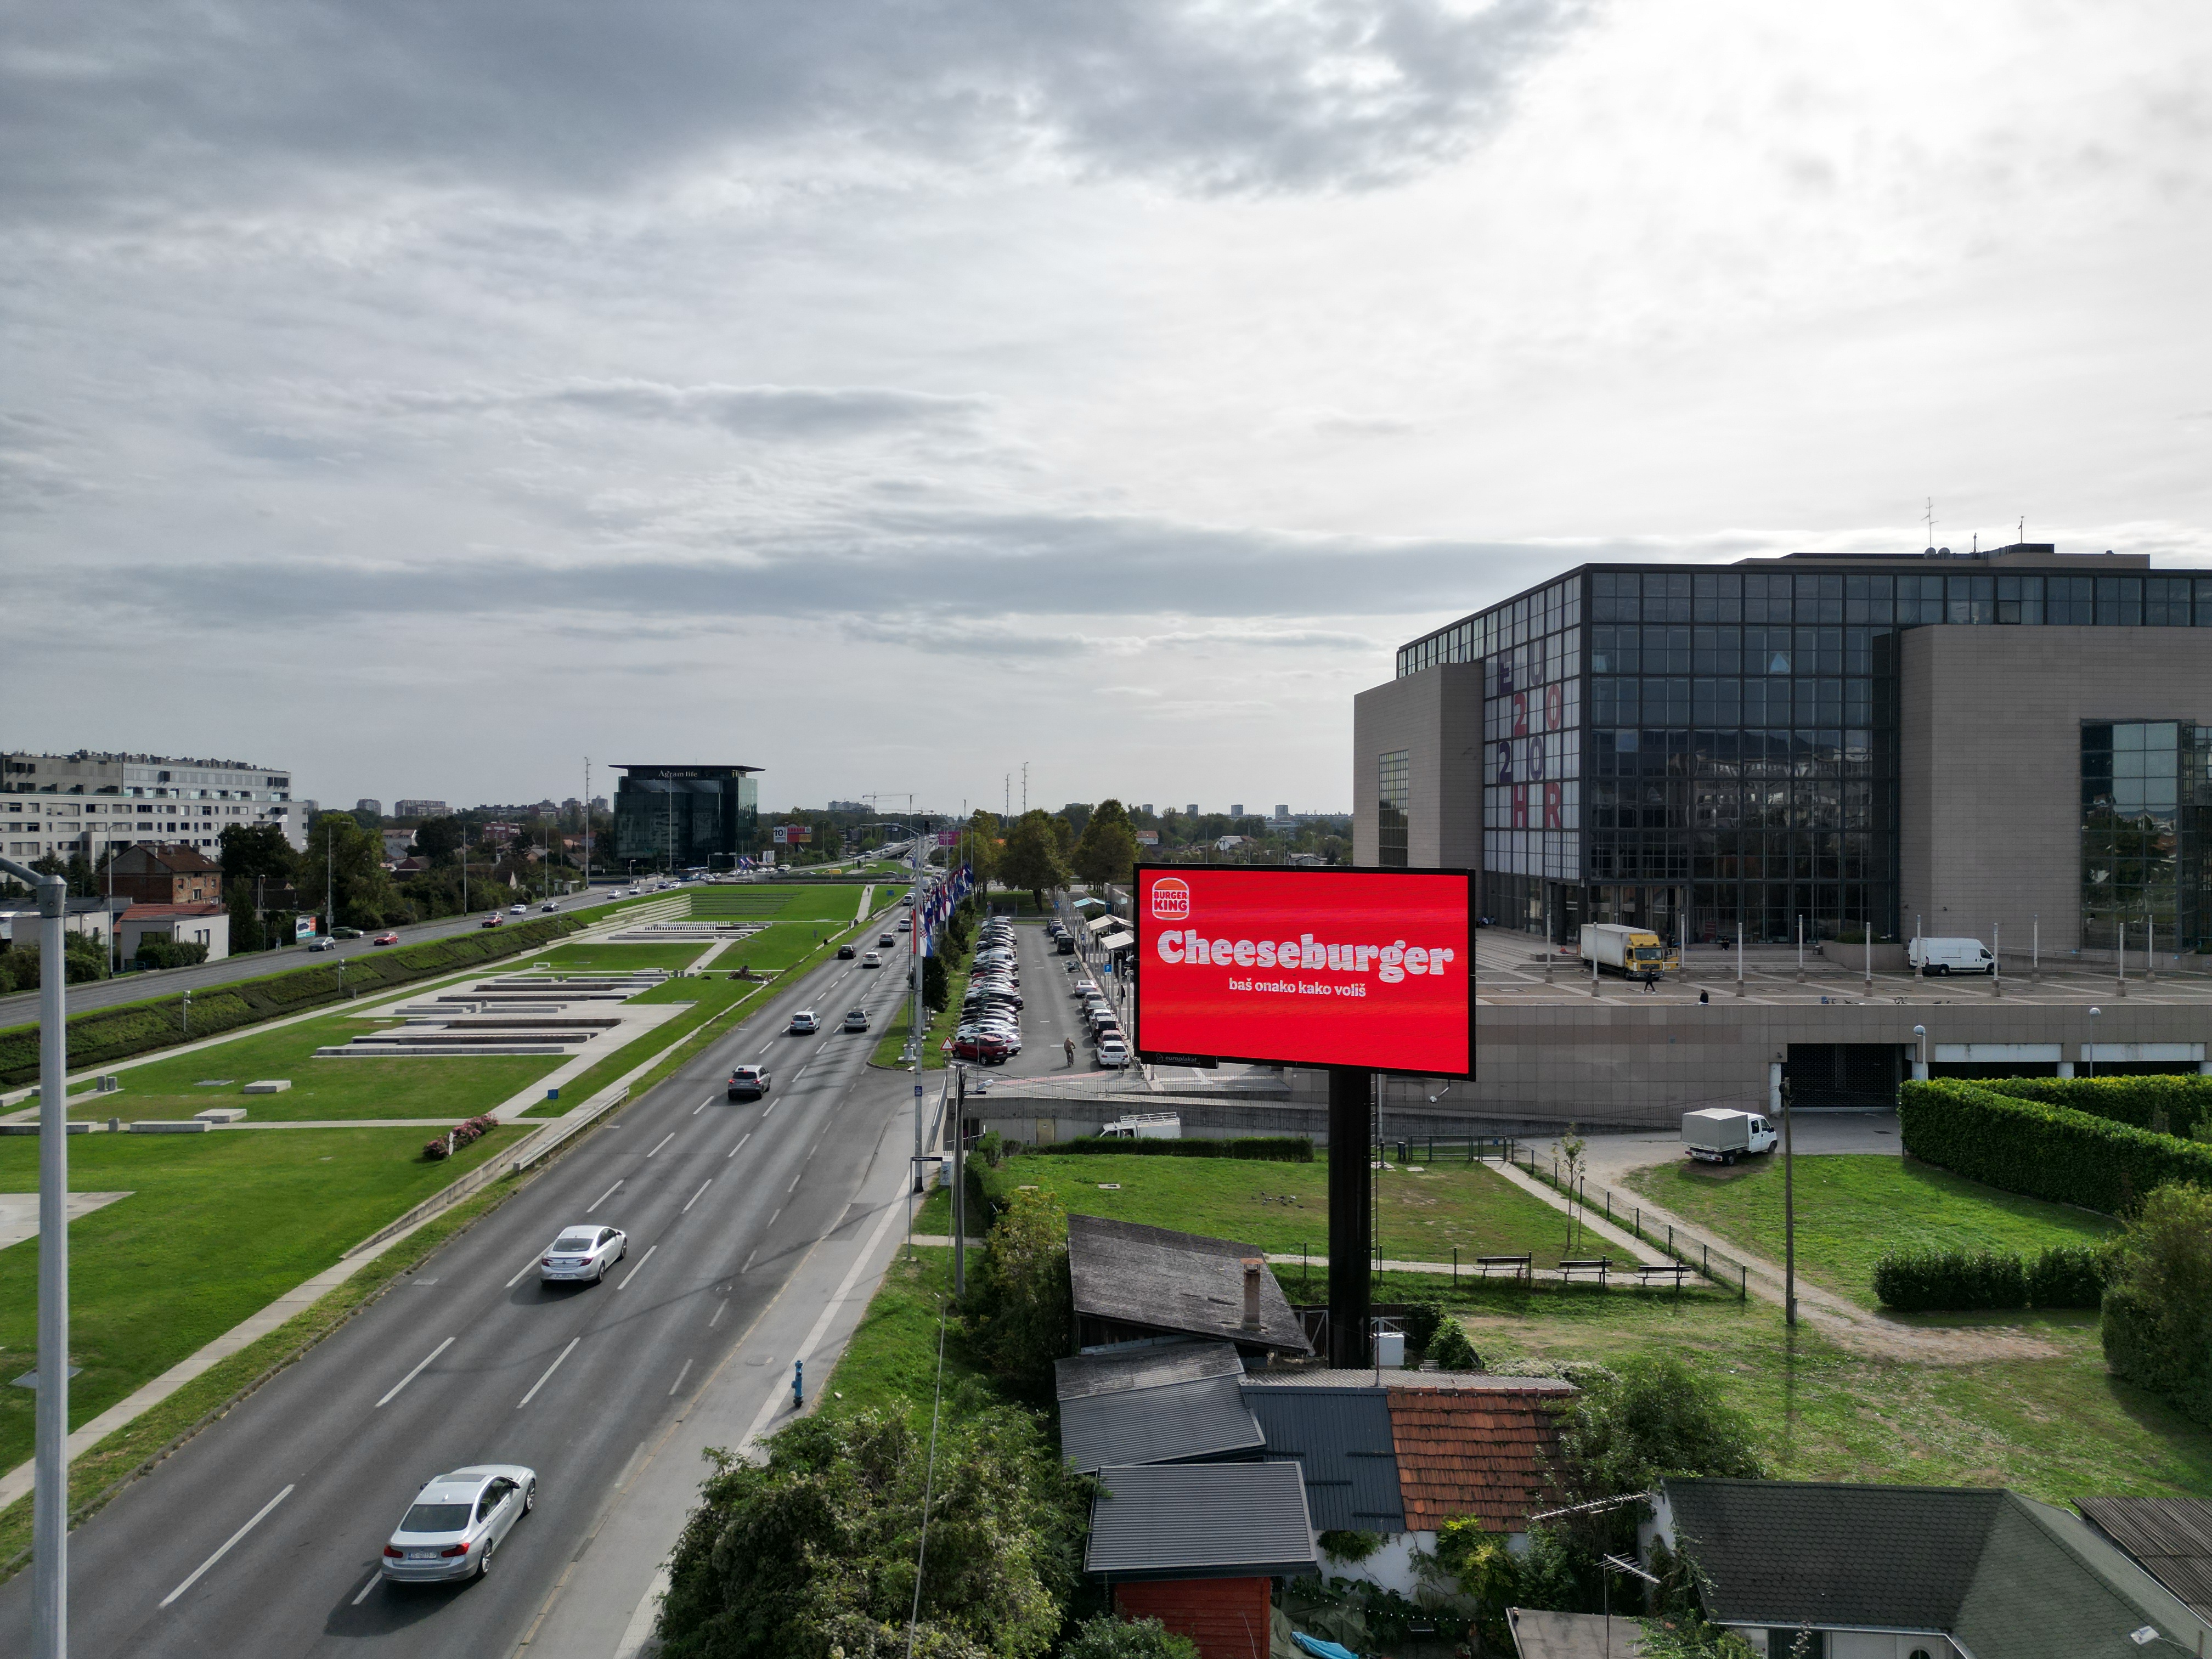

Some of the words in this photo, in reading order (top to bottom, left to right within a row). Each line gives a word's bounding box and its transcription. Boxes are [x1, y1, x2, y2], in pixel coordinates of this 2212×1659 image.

[1154, 891, 1187, 899] BURGER
[1154, 899, 1187, 911] KING
[1157, 929, 1454, 983] Cheeseburger
[1229, 977, 1252, 991] baš
[1255, 980, 1296, 993] onako
[1298, 981, 1332, 995] kako
[1334, 983, 1366, 997] voliš
